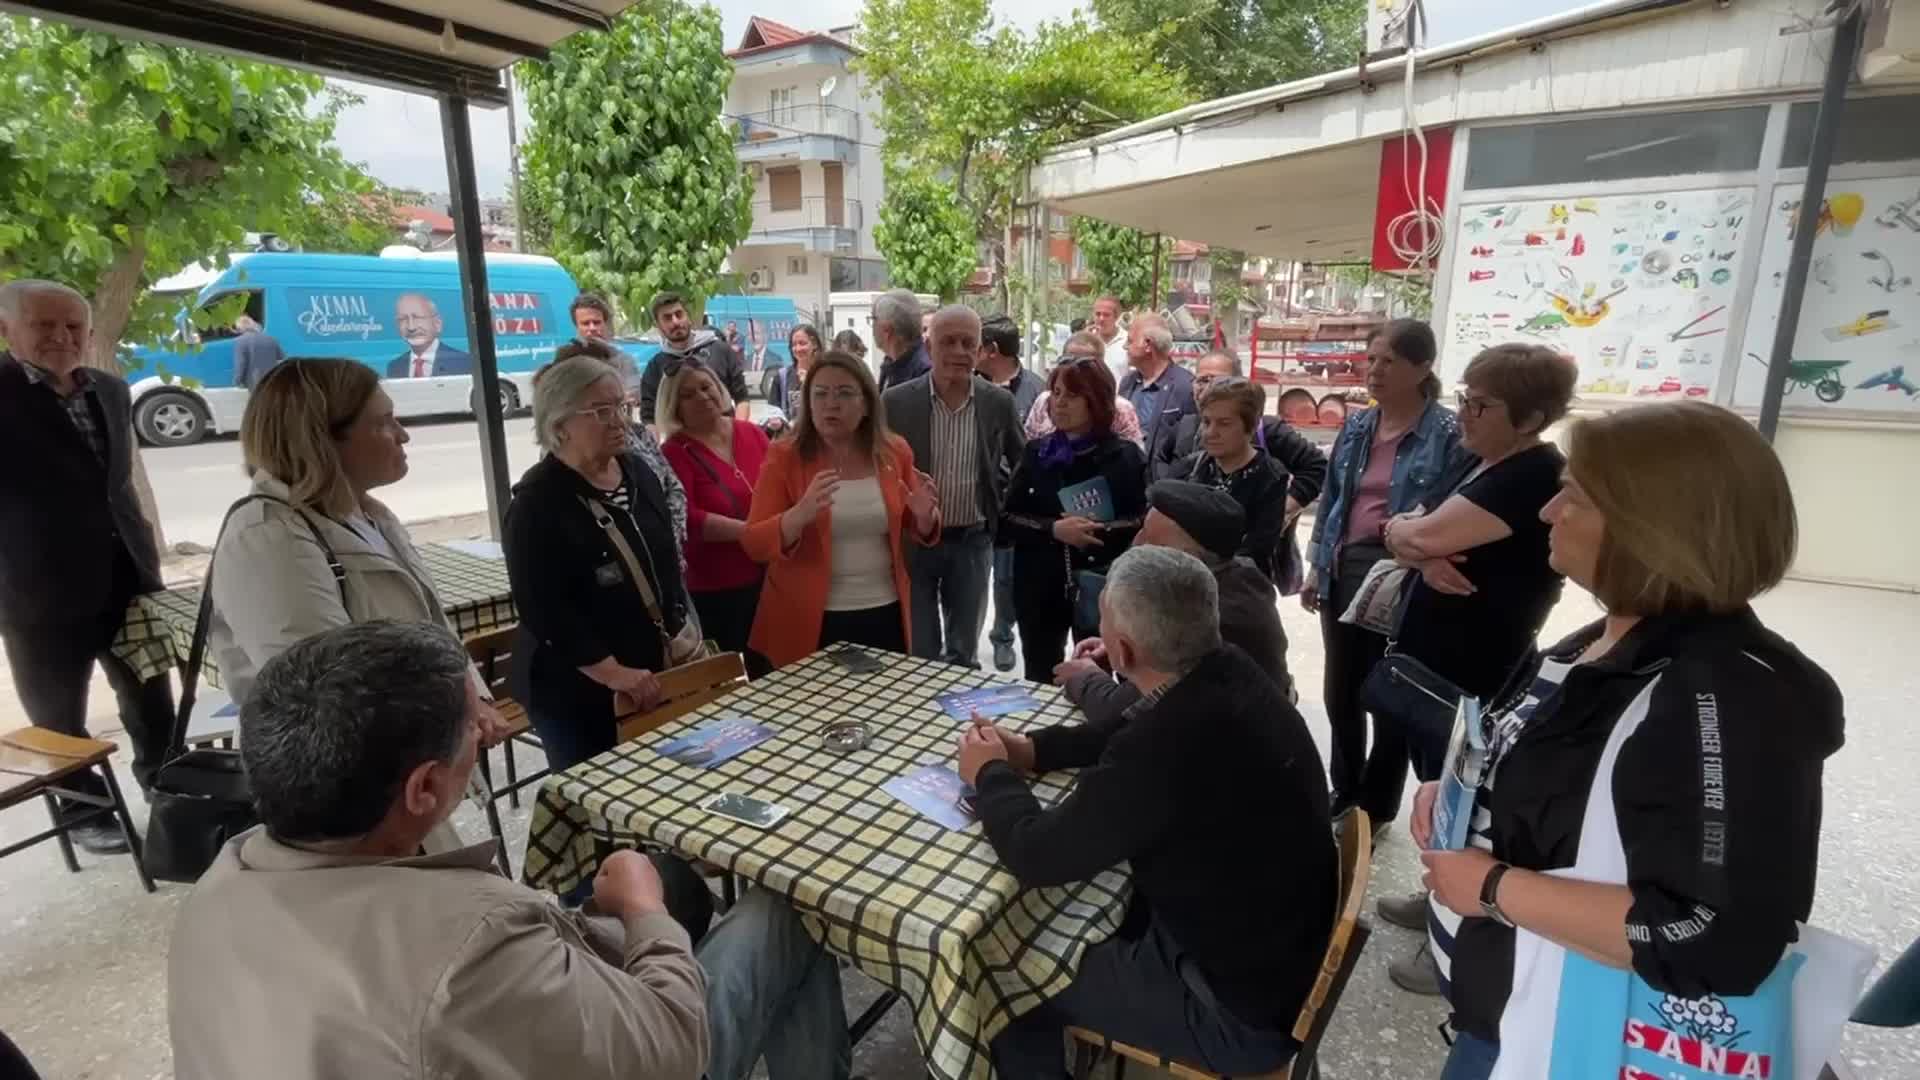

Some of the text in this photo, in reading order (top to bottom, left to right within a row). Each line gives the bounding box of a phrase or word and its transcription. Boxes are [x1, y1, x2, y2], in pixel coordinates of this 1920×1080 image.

[310, 295, 368, 316] KEMAL
[489, 292, 535, 310] ANA
[495, 313, 539, 335] ÖZ!
[1696, 693, 1722, 753] STRONGER
[1703, 756, 1725, 810] FOREVER
[1624, 1017, 1764, 1080] SANA
